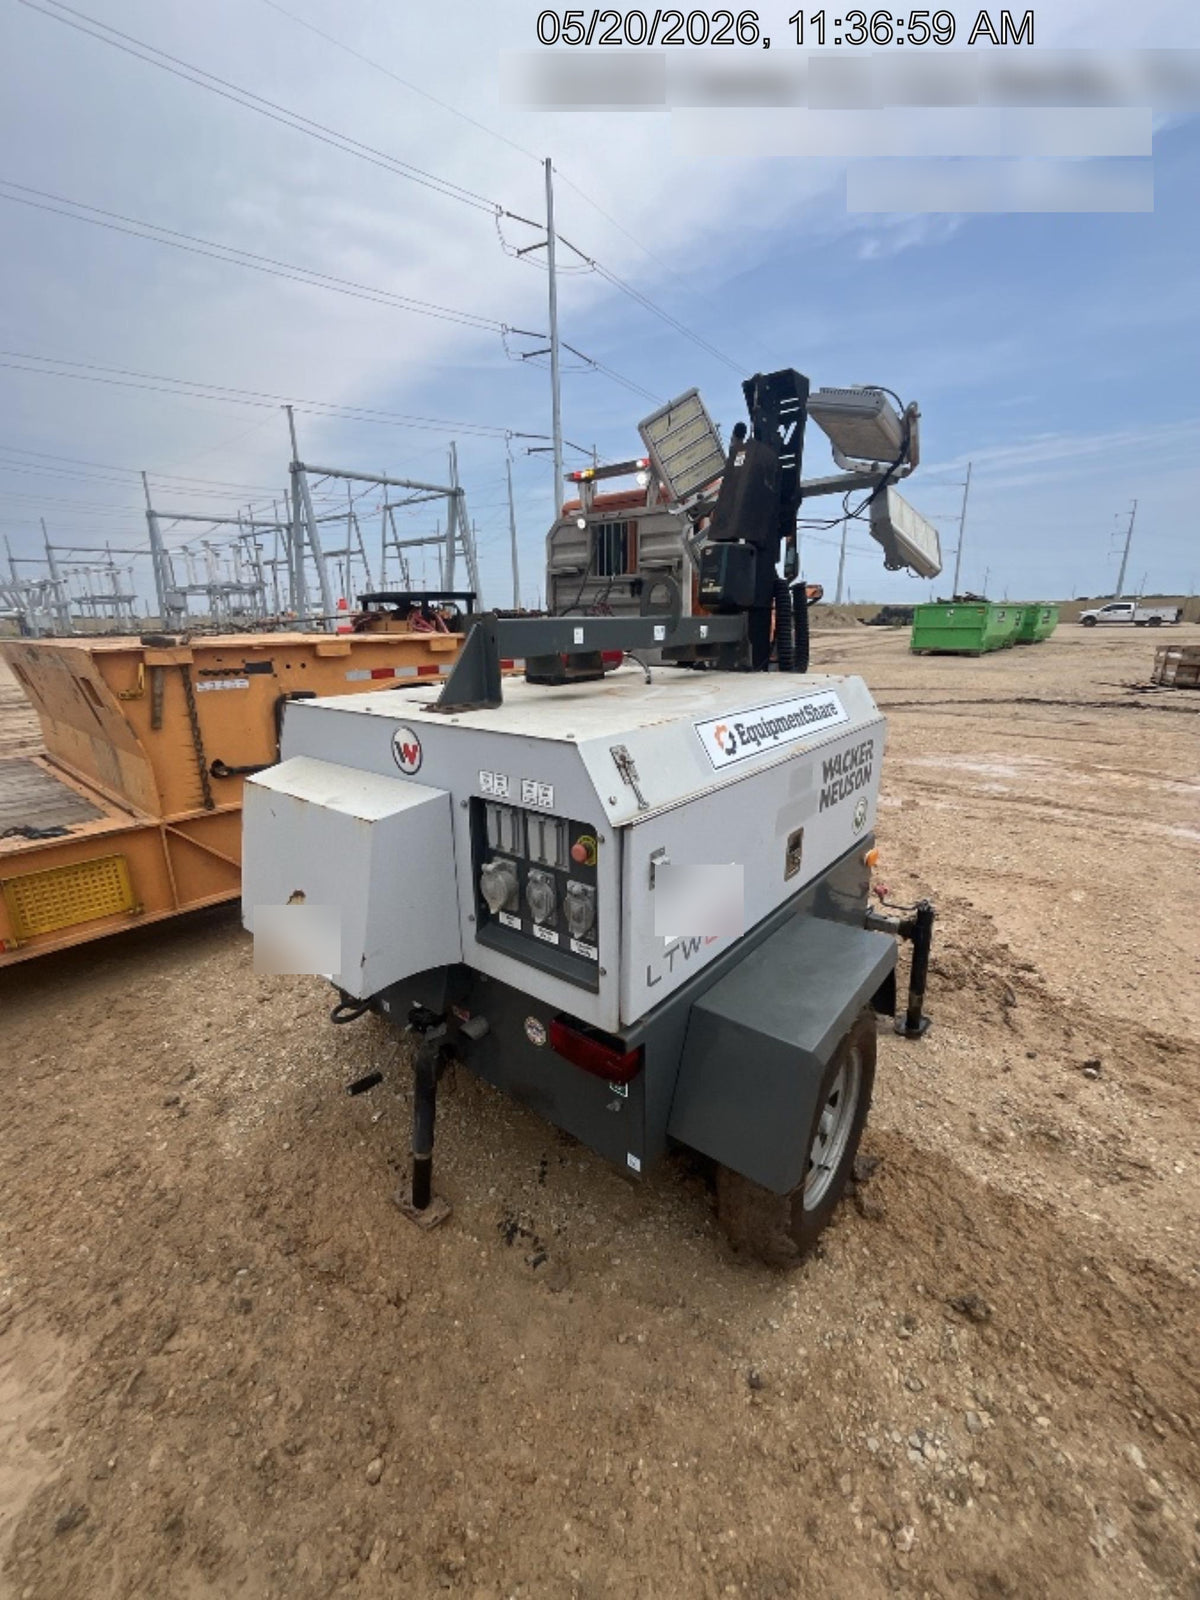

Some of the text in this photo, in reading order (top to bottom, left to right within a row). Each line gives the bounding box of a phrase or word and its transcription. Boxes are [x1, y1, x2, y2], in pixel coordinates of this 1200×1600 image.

[734, 701, 838, 747] EquipmentShare
[822, 739, 874, 785] WACKER
[819, 762, 873, 813] NEUSON
[647, 935, 719, 987] LTW
